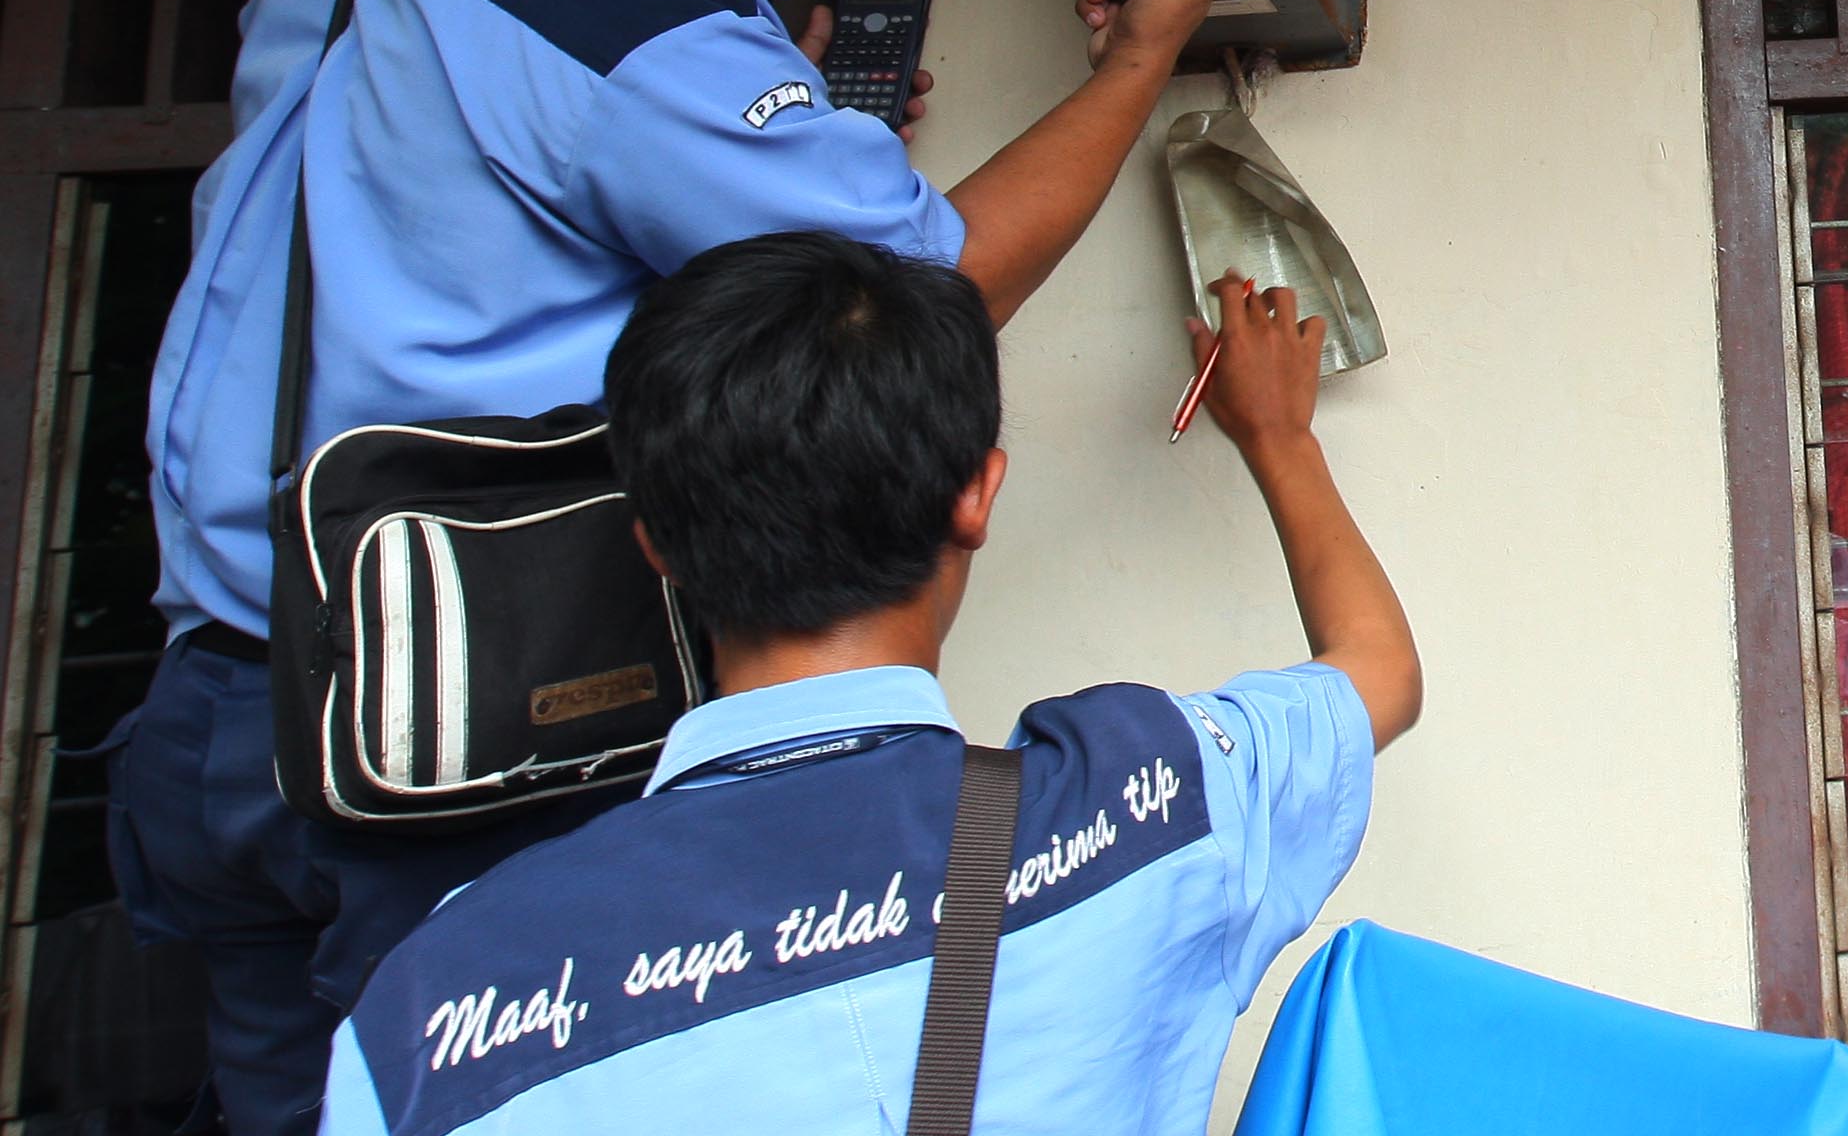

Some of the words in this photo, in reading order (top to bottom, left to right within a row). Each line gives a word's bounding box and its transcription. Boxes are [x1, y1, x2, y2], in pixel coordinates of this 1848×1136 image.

[425, 957, 589, 1071] Maaf,
[624, 929, 752, 1003] saya
[775, 871, 909, 963] tidak
[1123, 757, 1180, 823] tip
